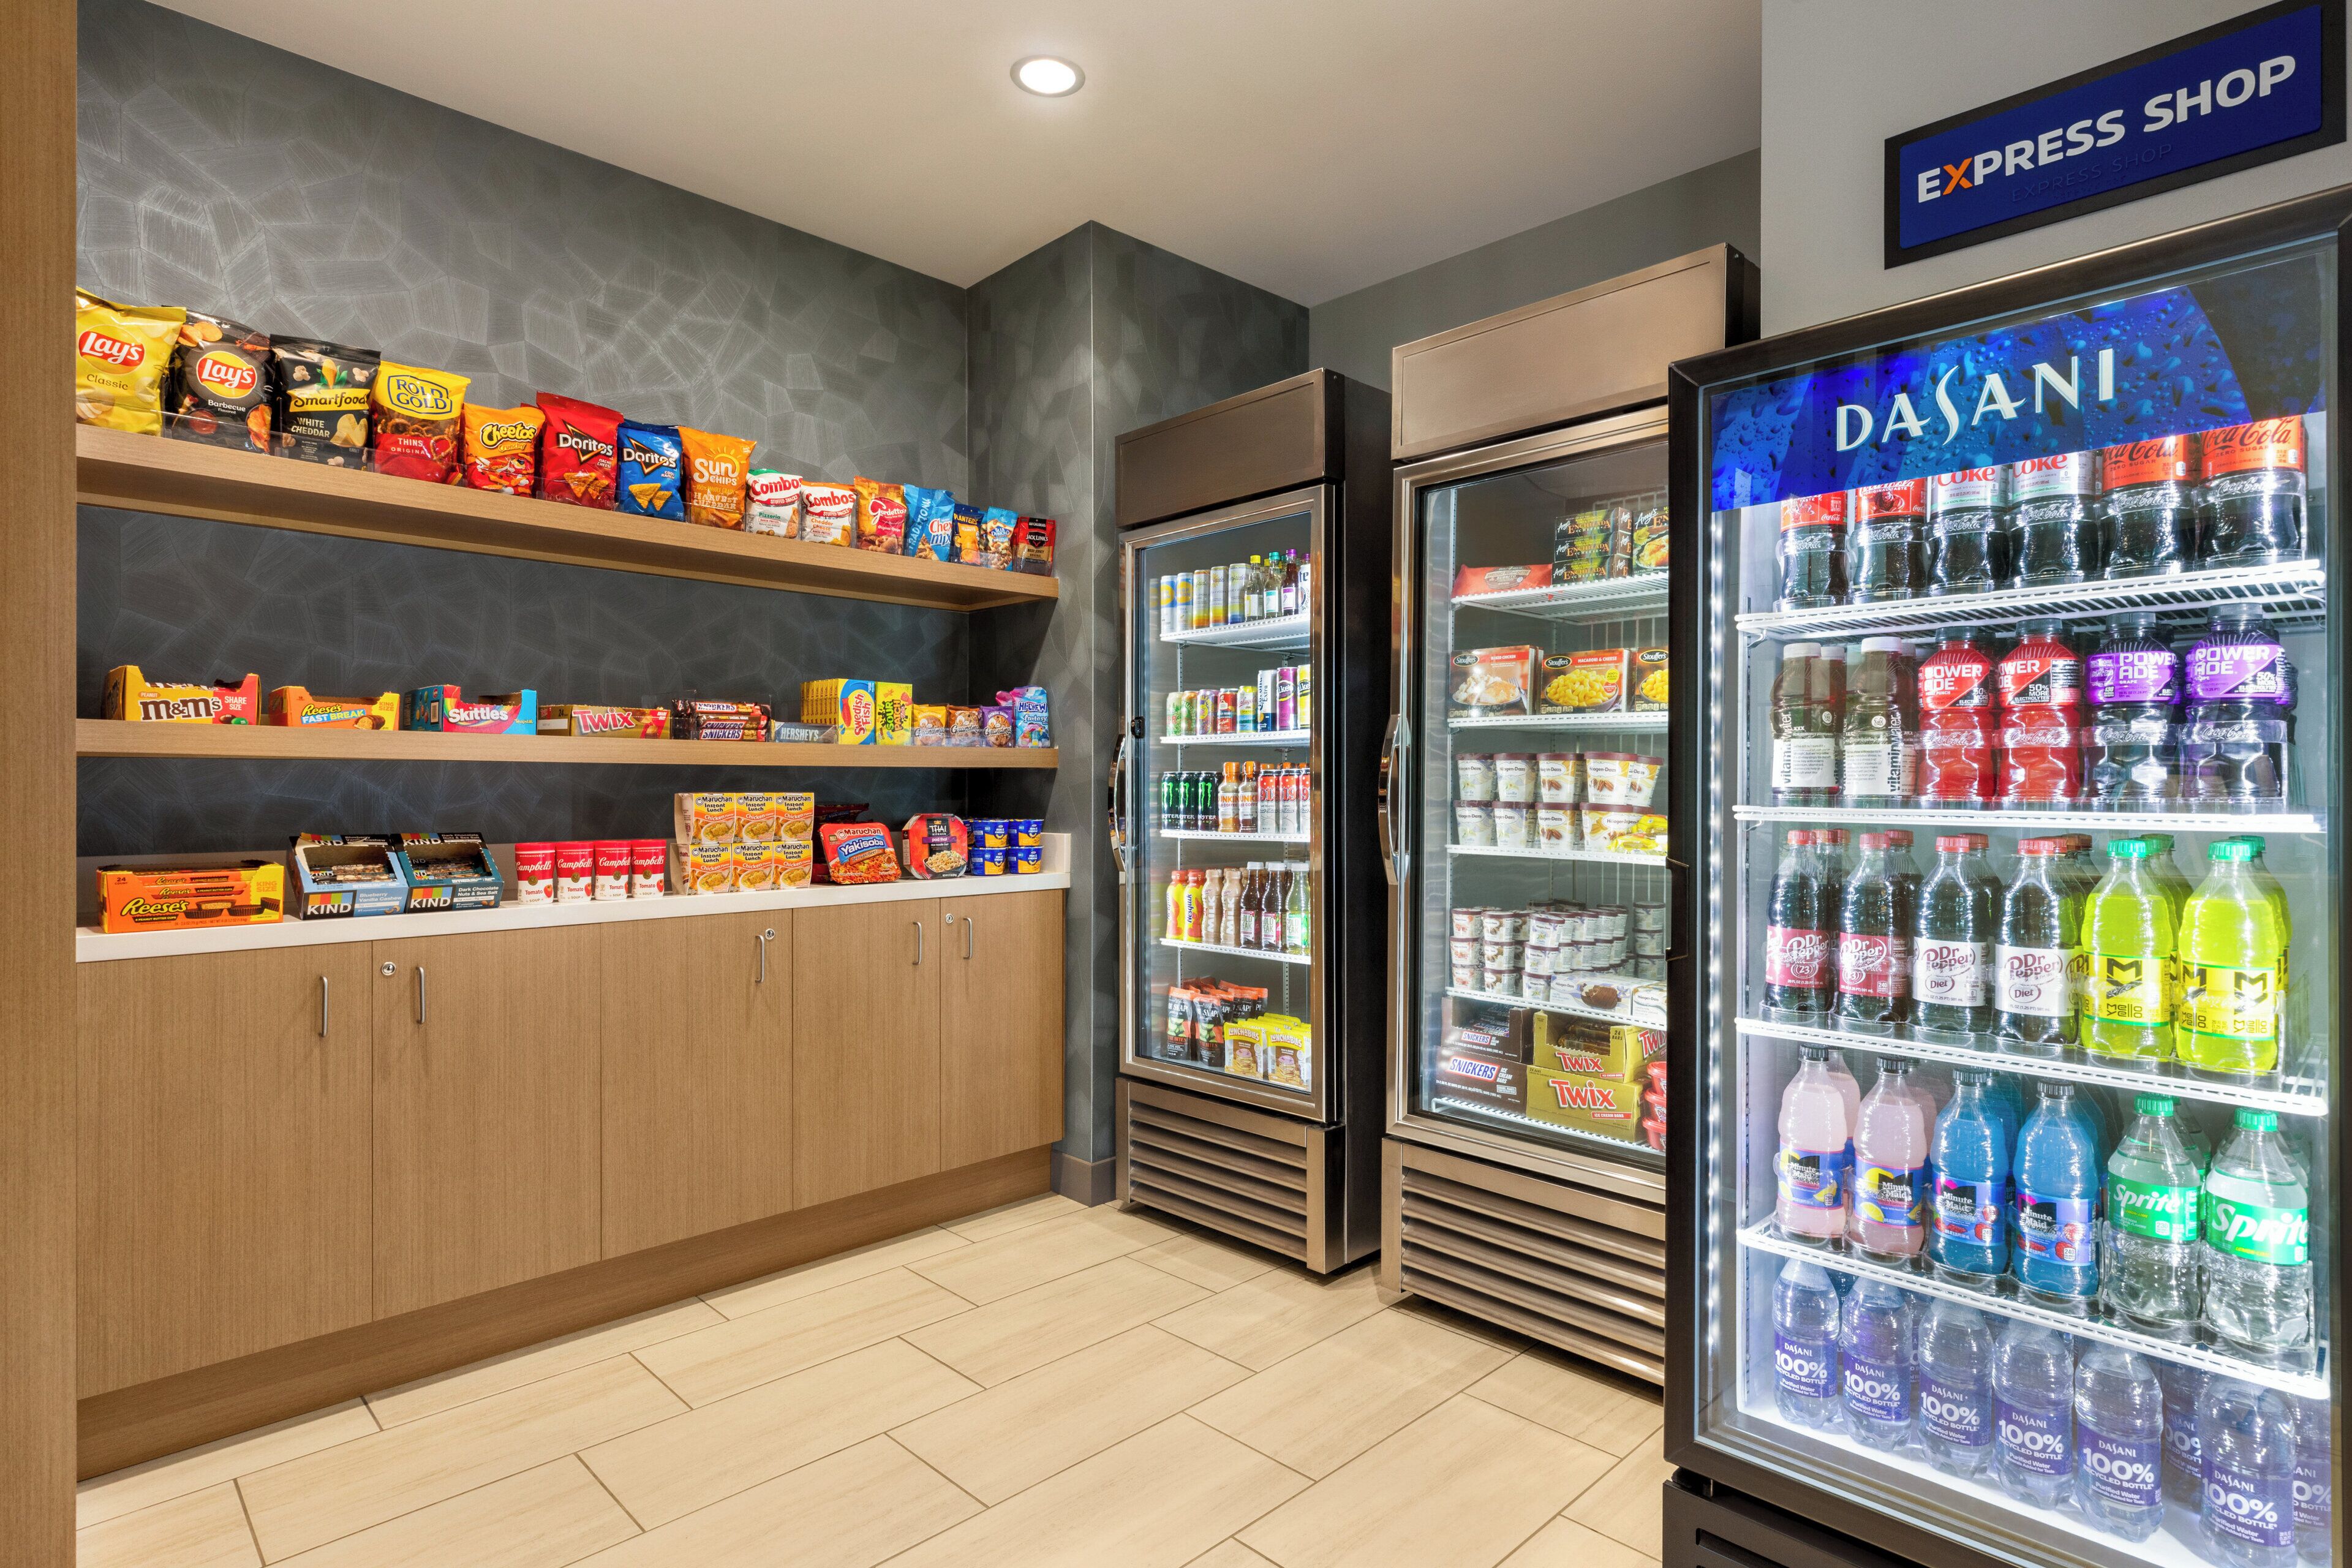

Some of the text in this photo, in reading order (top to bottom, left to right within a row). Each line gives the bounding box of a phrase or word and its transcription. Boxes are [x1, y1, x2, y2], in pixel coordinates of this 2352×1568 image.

[1918, 56, 2296, 203] EXPRESS SHOP
[2012, 143, 2173, 203] EXPRESS SHOP
[82, 332, 142, 364] Lay's
[202, 358, 256, 388] Lay's
[86, 374, 128, 390] Classic
[397, 379, 443, 398] ROLD
[208, 399, 246, 412] Barbecue
[294, 391, 369, 407] Smartfood
[396, 393, 447, 410] GOLD
[1836, 348, 2114, 453] DASANI
[297, 417, 325, 428] WHITE
[291, 426, 330, 438] CHEDDAR
[481, 423, 537, 447] Cheetos
[398, 438, 423, 447] THINS
[498, 442, 526, 452] Crunchy
[559, 434, 613, 456] Doritos
[623, 448, 676, 468] Doritos
[2128, 459, 2157, 468] SUGAR
[693, 458, 739, 483] Sun
[709, 475, 737, 486] CHIPS
[805, 491, 856, 507] Combos
[870, 498, 907, 525] Gardetto's
[954, 513, 979, 525] PLANTERS
[1635, 508, 1658, 529] Amy's
[929, 518, 952, 533] Chex
[1558, 520, 1570, 532] Amy's
[1568, 518, 1610, 534] ENCHILADA
[1456, 656, 1477, 666] Stouffer's
[1642, 651, 1667, 661] Stouffer's
[2119, 652, 2177, 667] POWER
[2195, 646, 2271, 661] POWER
[1547, 658, 1569, 668] Stouffer's
[2194, 661, 2237, 676] ADE
[1924, 664, 1983, 678] POWER
[2119, 666, 2160, 679] ADE
[140, 697, 221, 720] m&m's
[302, 704, 342, 716] Reese's
[1017, 701, 1047, 712] HI-CHEW
[303, 710, 364, 723] FAST BREAK
[448, 707, 508, 723] Skittles
[853, 694, 864, 736] Swedish
[862, 703, 871, 726] Fish
[892, 699, 902, 731] PATCH
[703, 729, 742, 739] SNICKERS
[780, 728, 819, 741] HERSHEY'S
[840, 838, 884, 856] Yakisoba
[516, 861, 552, 873] Campbell's
[557, 858, 593, 870] Campbell's
[631, 856, 664, 867] Campbell's
[122, 899, 189, 916] Reese's
[307, 903, 352, 915] KIND
[410, 898, 451, 908] KIND
[1207, 895, 1215, 932] MILK
[1806, 934, 1822, 947] Dr
[1852, 939, 1870, 950] Dr
[1787, 937, 1829, 962] Pepper
[1939, 946, 1959, 957] Dr
[2024, 954, 2046, 965] Dr
[1800, 965, 1810, 974] 23
[1930, 978, 1948, 989] Diet
[2015, 987, 2034, 998] Diet
[1229, 1027, 1259, 1041] LUNCHABLES
[1463, 1033, 1490, 1044] SNICKERS
[1450, 1058, 1496, 1080] SNICKERS
[1790, 1161, 1816, 1174] Minute
[1792, 1170, 1812, 1180] Maid
[1882, 1182, 1910, 1193] Minute
[1886, 1189, 1907, 1199] Maid
[1943, 1192, 1972, 1204] Minute
[2113, 1184, 2180, 1213] Sprite
[1945, 1200, 1968, 1212] Maid
[2024, 1207, 2052, 1221] Minute
[2025, 1216, 2047, 1229] Maid
[1784, 1342, 1812, 1357] DASANI
[1775, 1349, 1827, 1378] 100%
[1855, 1363, 1885, 1378] DASANI
[1782, 1378, 1799, 1389] Purified
[1845, 1370, 1900, 1401] 100%
[1932, 1385, 1963, 1401] DASANI
[1921, 1392, 1980, 1425] 100%
[2013, 1412, 2047, 1429] DASANI
[1999, 1419, 2064, 1453] 100%
[2098, 1439, 2136, 1457] DASANI
[2083, 1448, 2154, 1483] 100%
[2214, 1470, 2255, 1493] DASANI
[2095, 1482, 2140, 1500] Purified Water
[2204, 1479, 2278, 1523] 100%
